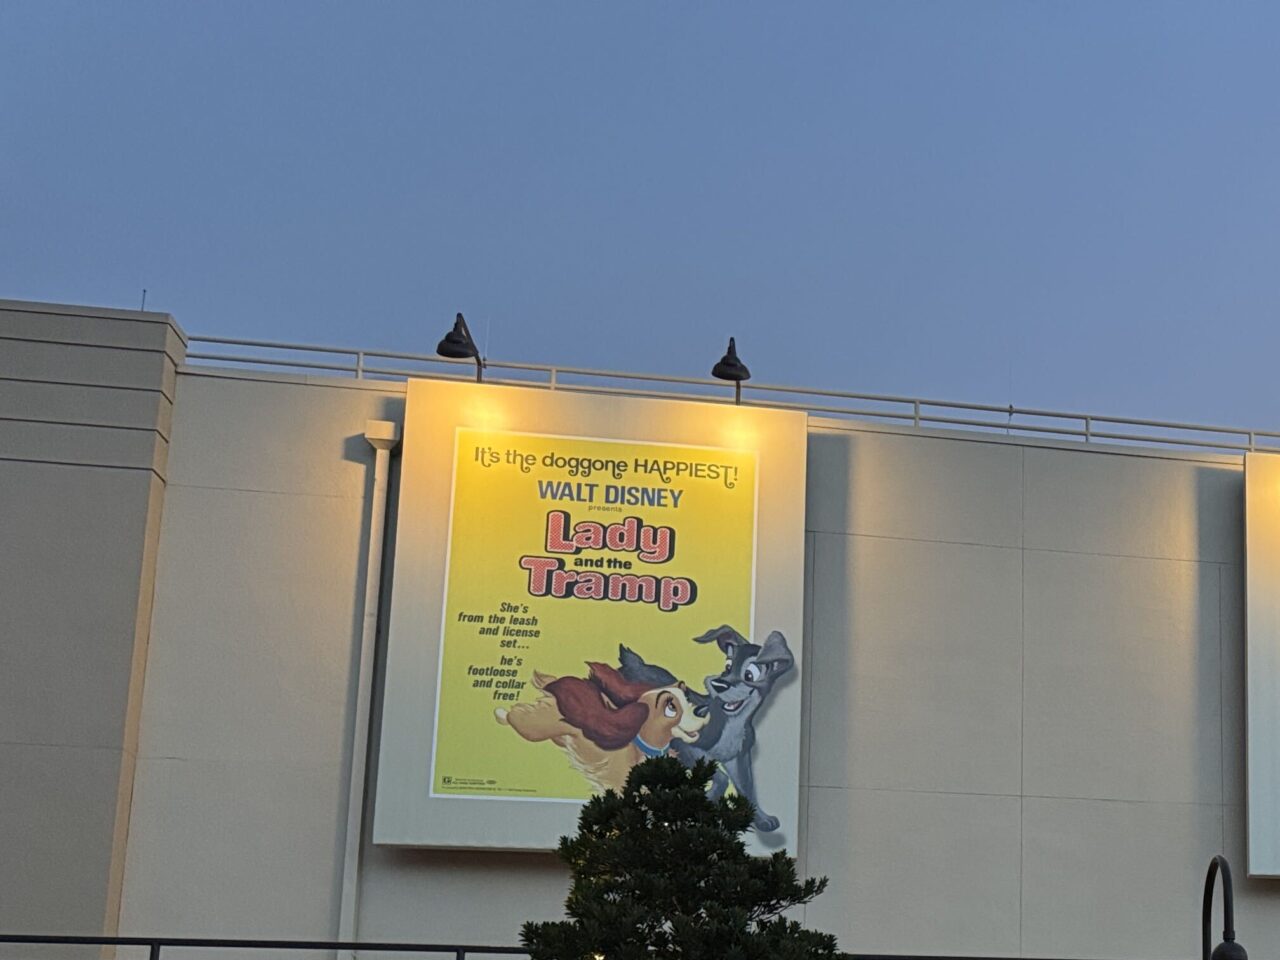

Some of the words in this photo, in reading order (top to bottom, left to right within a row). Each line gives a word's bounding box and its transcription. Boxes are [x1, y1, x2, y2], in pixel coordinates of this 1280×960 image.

[474, 446, 501, 468] It's
[505, 449, 537, 474] the
[542, 452, 628, 480] doggone
[633, 458, 738, 489] HAPPIEST!
[538, 480, 599, 503] WALT
[604, 484, 684, 508] DISNEY
[588, 505, 623, 513] presents
[545, 510, 676, 564] Lady
[574, 557, 604, 569] and
[606, 558, 632, 570] the
[519, 555, 698, 612] Tramp
[500, 602, 529, 614] She's
[458, 612, 484, 623] from
[488, 614, 506, 625] the
[509, 615, 539, 626] leash
[479, 625, 500, 636] and
[502, 626, 541, 638] license
[500, 639, 530, 649] set...
[500, 655, 523, 666] he's
[467, 665, 518, 677] footloose
[472, 678, 493, 688] and
[495, 679, 527, 689] collar
[493, 690, 521, 701] free!
